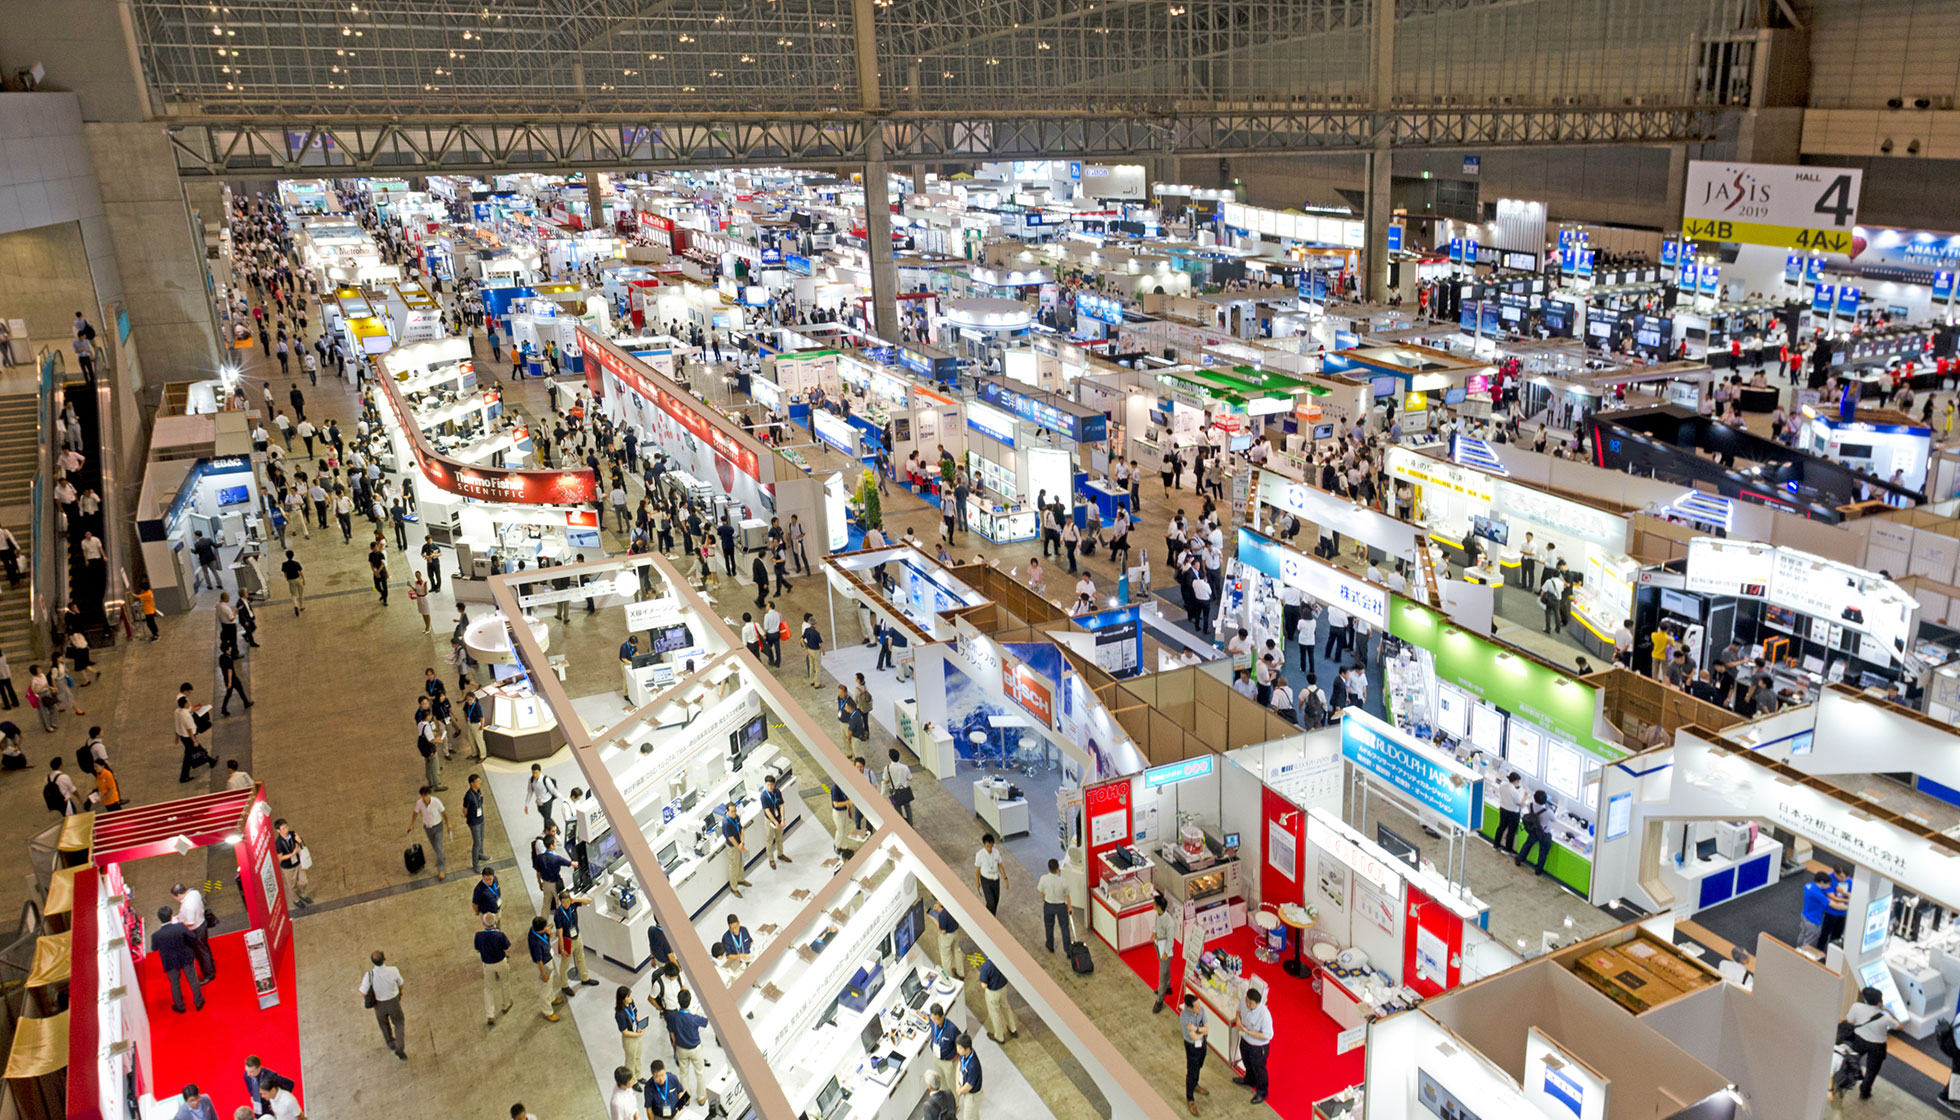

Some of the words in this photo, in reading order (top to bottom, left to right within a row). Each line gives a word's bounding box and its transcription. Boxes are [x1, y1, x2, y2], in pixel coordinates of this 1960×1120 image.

[1703, 167, 1771, 212] JASIS
[1796, 173, 1822, 183] HALL
[1738, 204, 1769, 219] 2019
[1814, 174, 1854, 227] 4
[1704, 220, 1733, 239] 4B
[1796, 229, 1828, 250] 4A
[457, 483, 525, 498] SCIENTIFIC
[1341, 584, 1383, 617] 株式会社
[1004, 670, 1049, 714] BUSCH
[1377, 737, 1426, 776] RUDOLPH
[1088, 783, 1130, 804] TOHO
[1779, 802, 1907, 869] 日本分析工業株式会社
